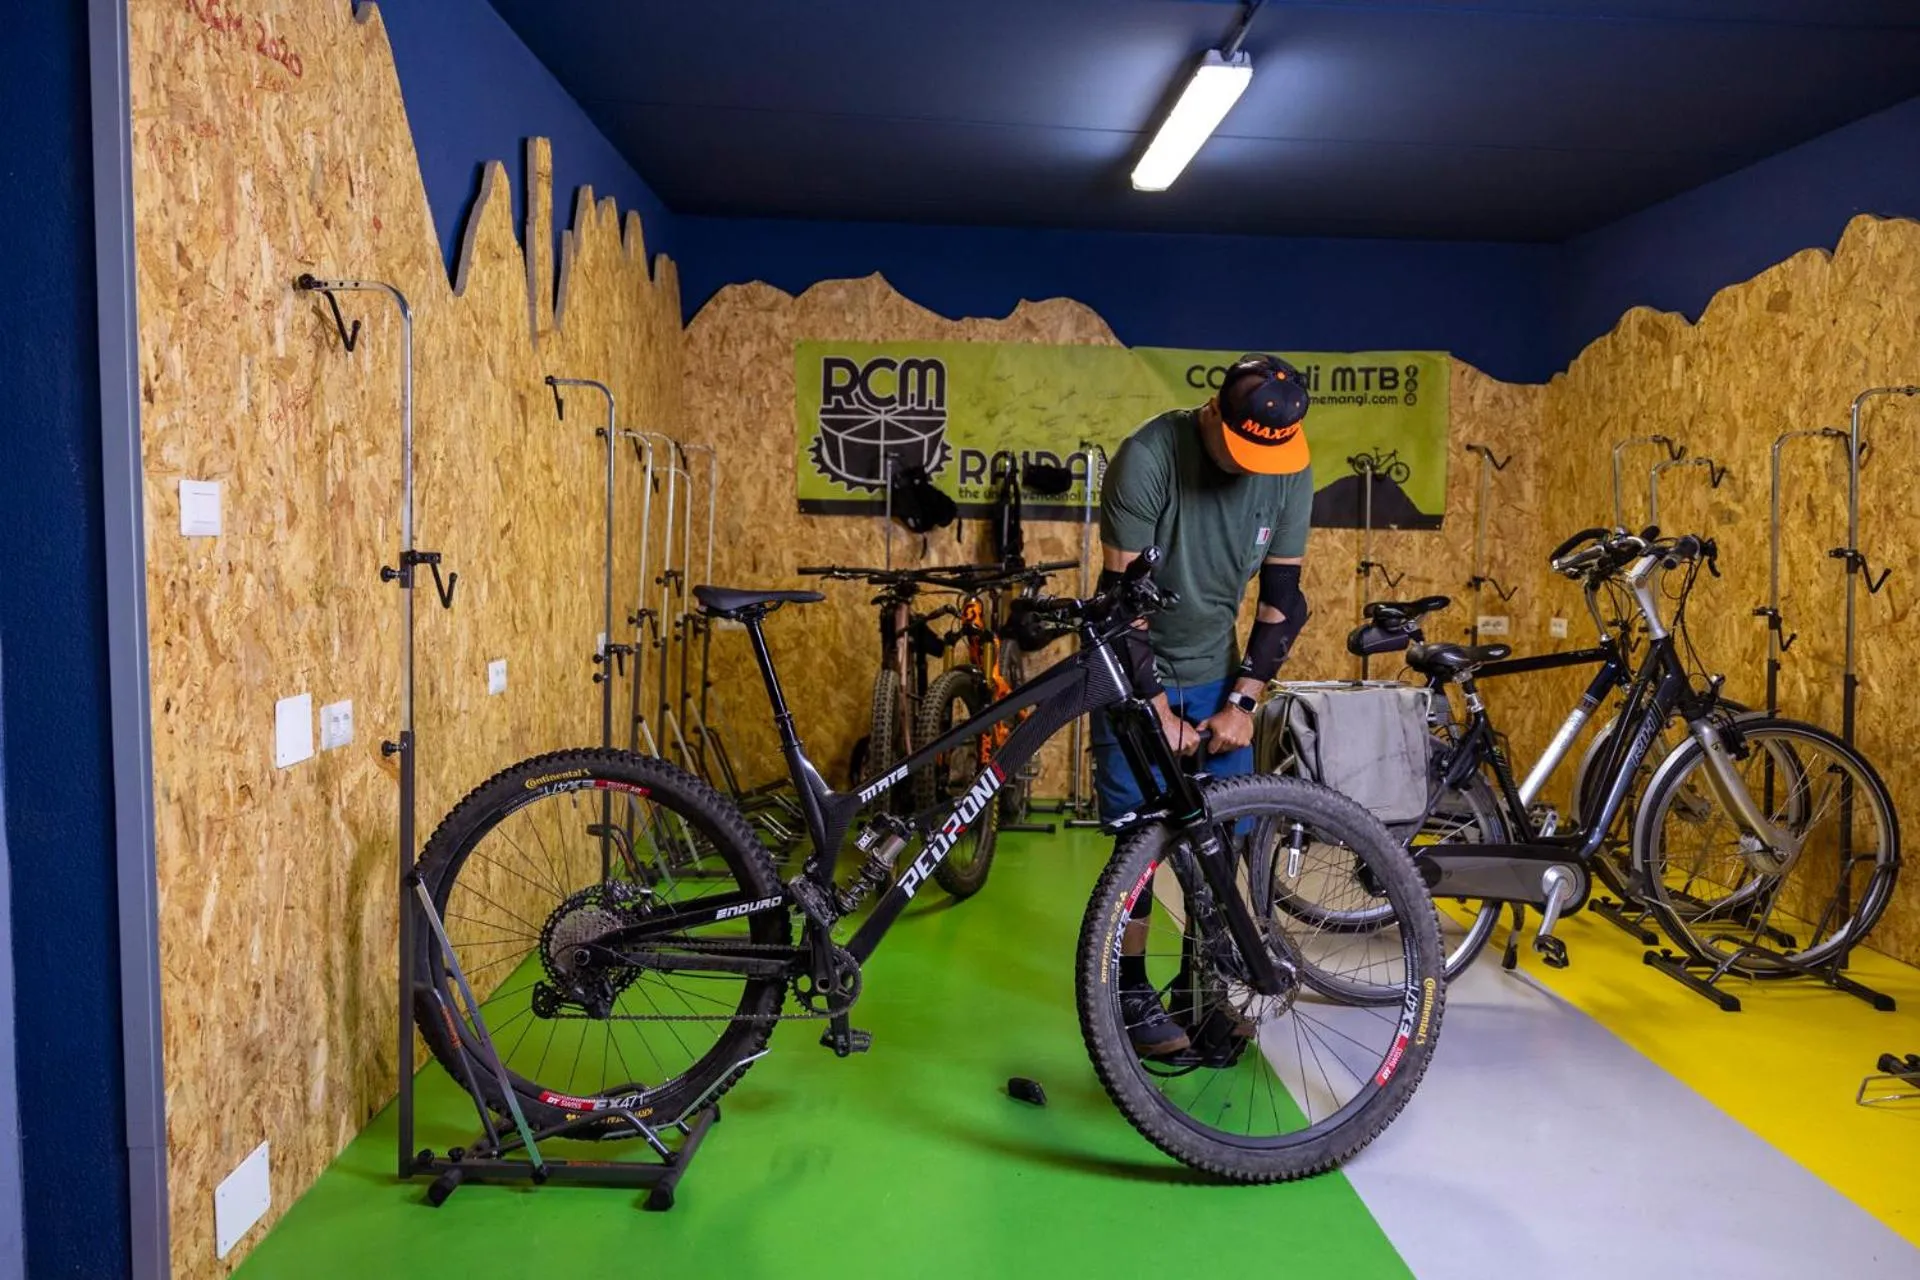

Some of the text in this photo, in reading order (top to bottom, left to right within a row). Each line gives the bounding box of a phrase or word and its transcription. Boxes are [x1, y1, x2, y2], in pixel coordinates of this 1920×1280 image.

[822, 356, 947, 410] RCM
[1331, 366, 1400, 391] MTB
[959, 487, 981, 499] the
[524, 770, 583, 790] Continental
[714, 895, 783, 920] ENDURO
[1418, 977, 1436, 1038] Continental
